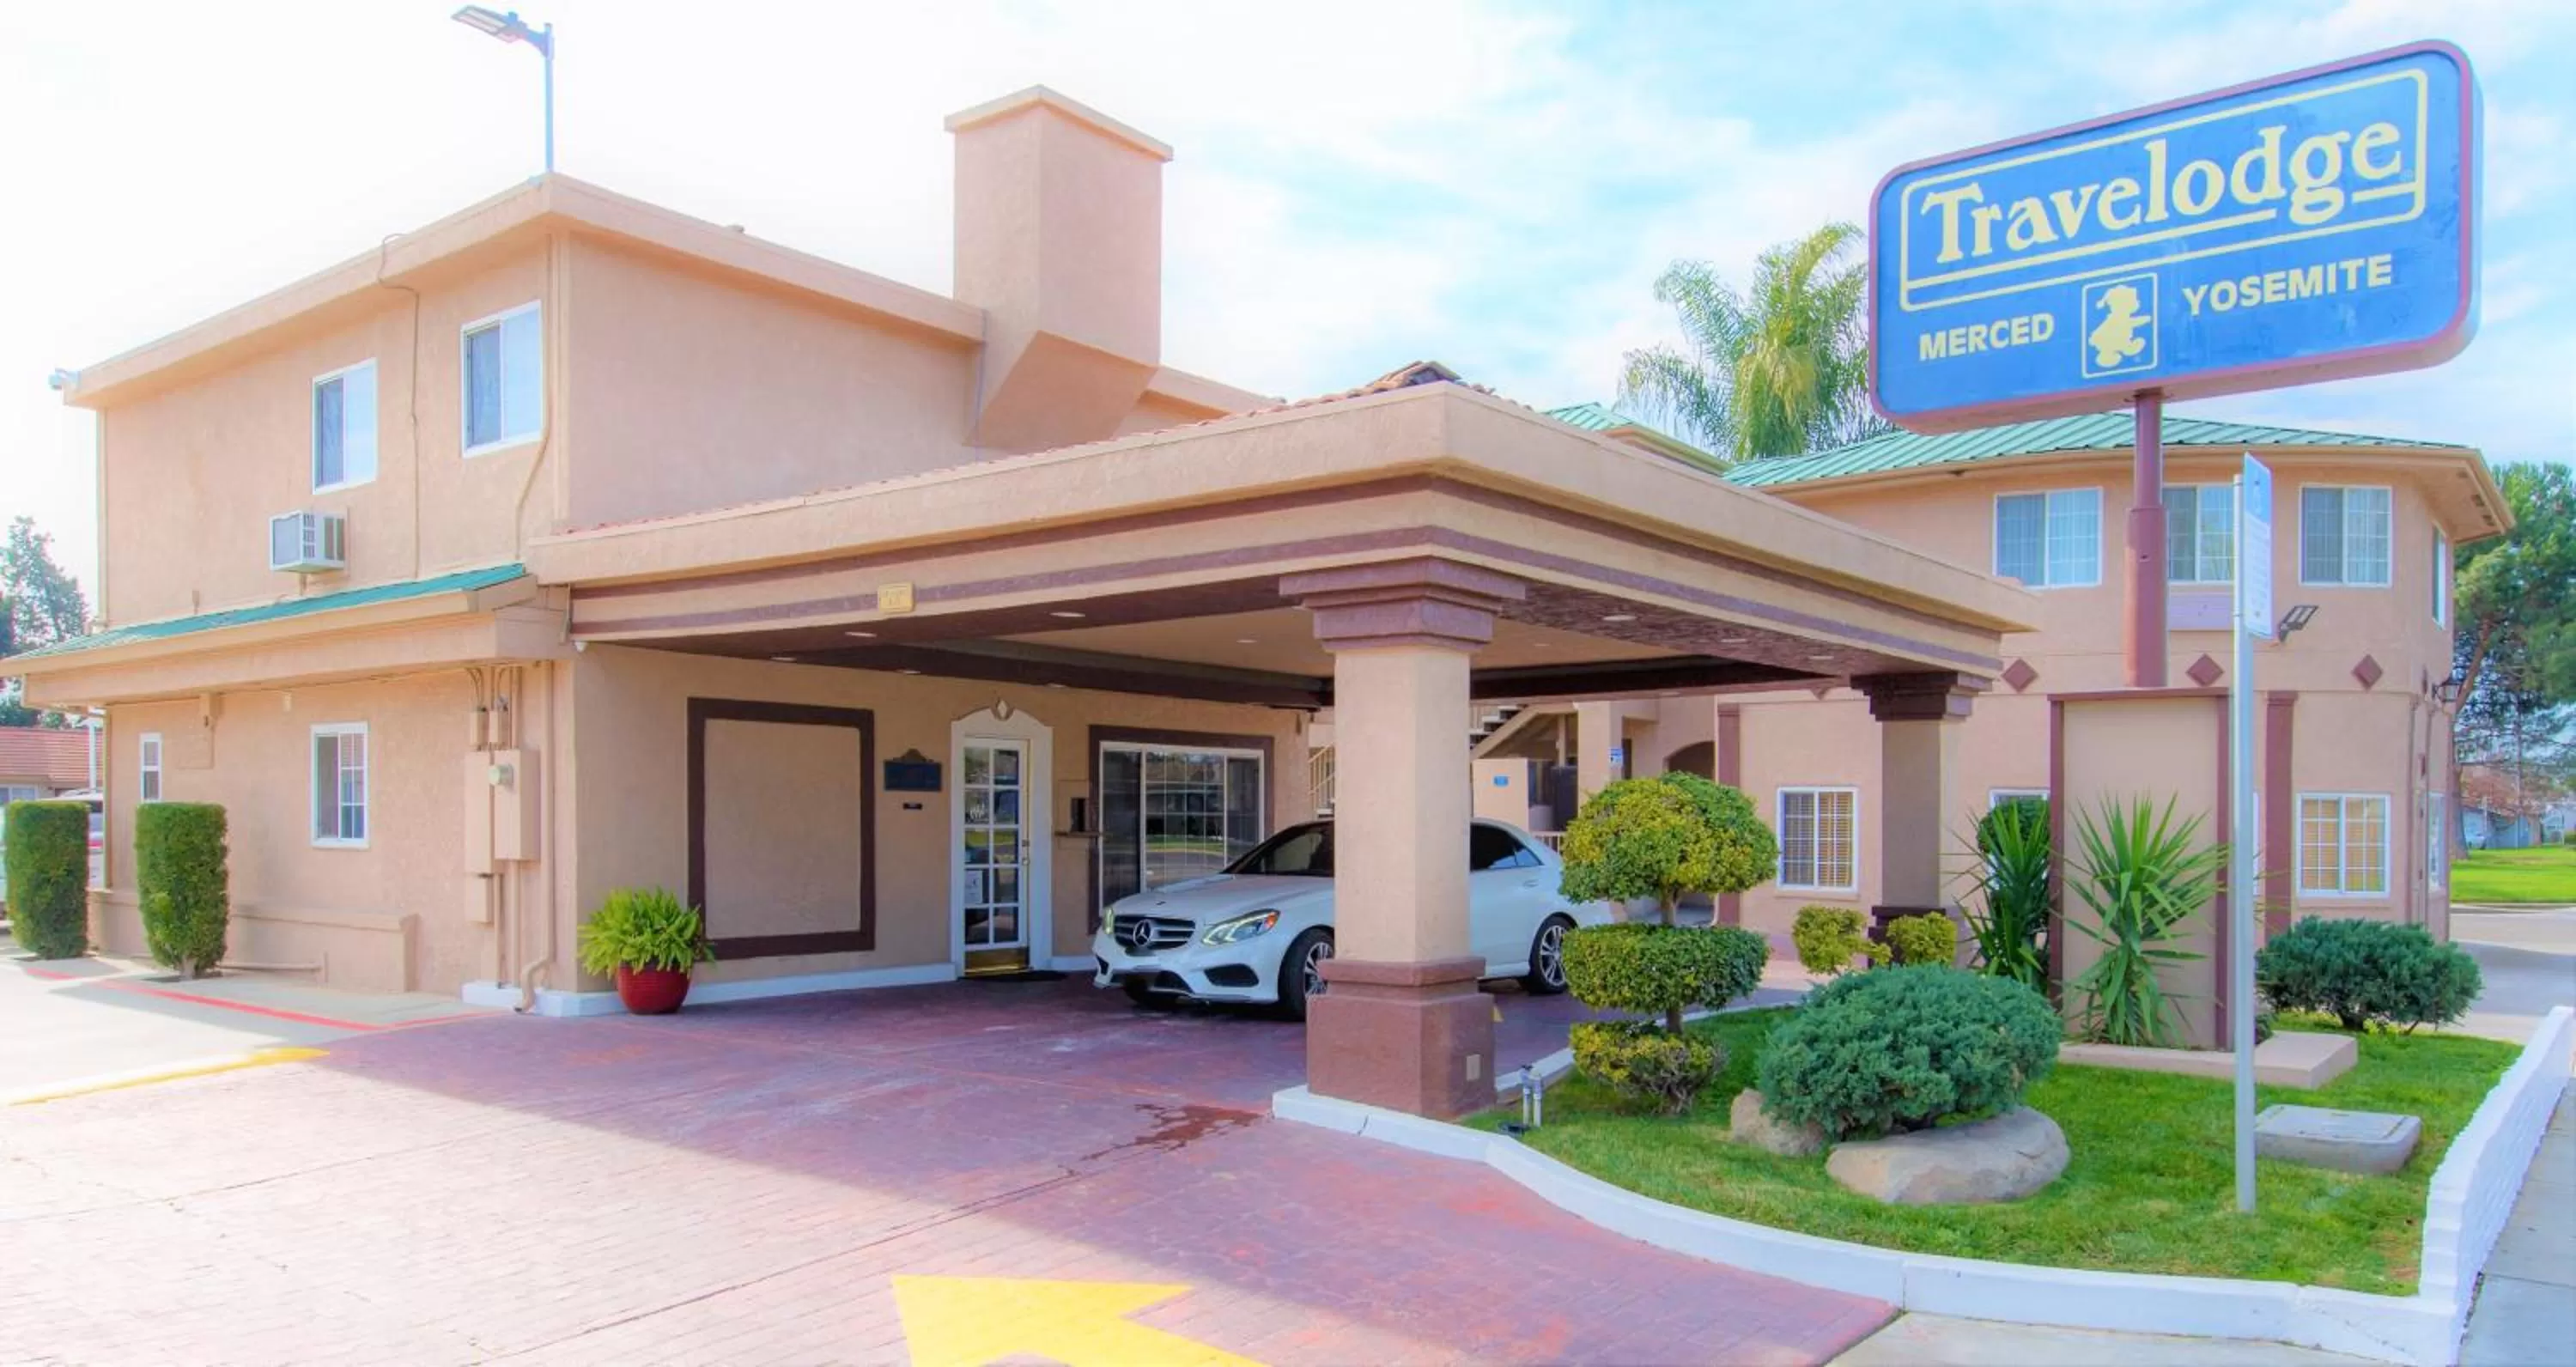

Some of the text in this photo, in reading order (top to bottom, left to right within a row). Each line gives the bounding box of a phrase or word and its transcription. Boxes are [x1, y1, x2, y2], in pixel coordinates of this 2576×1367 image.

[1921, 122, 2401, 263] Travelodge
[1920, 254, 2391, 361] MERCED YOSEMITE
